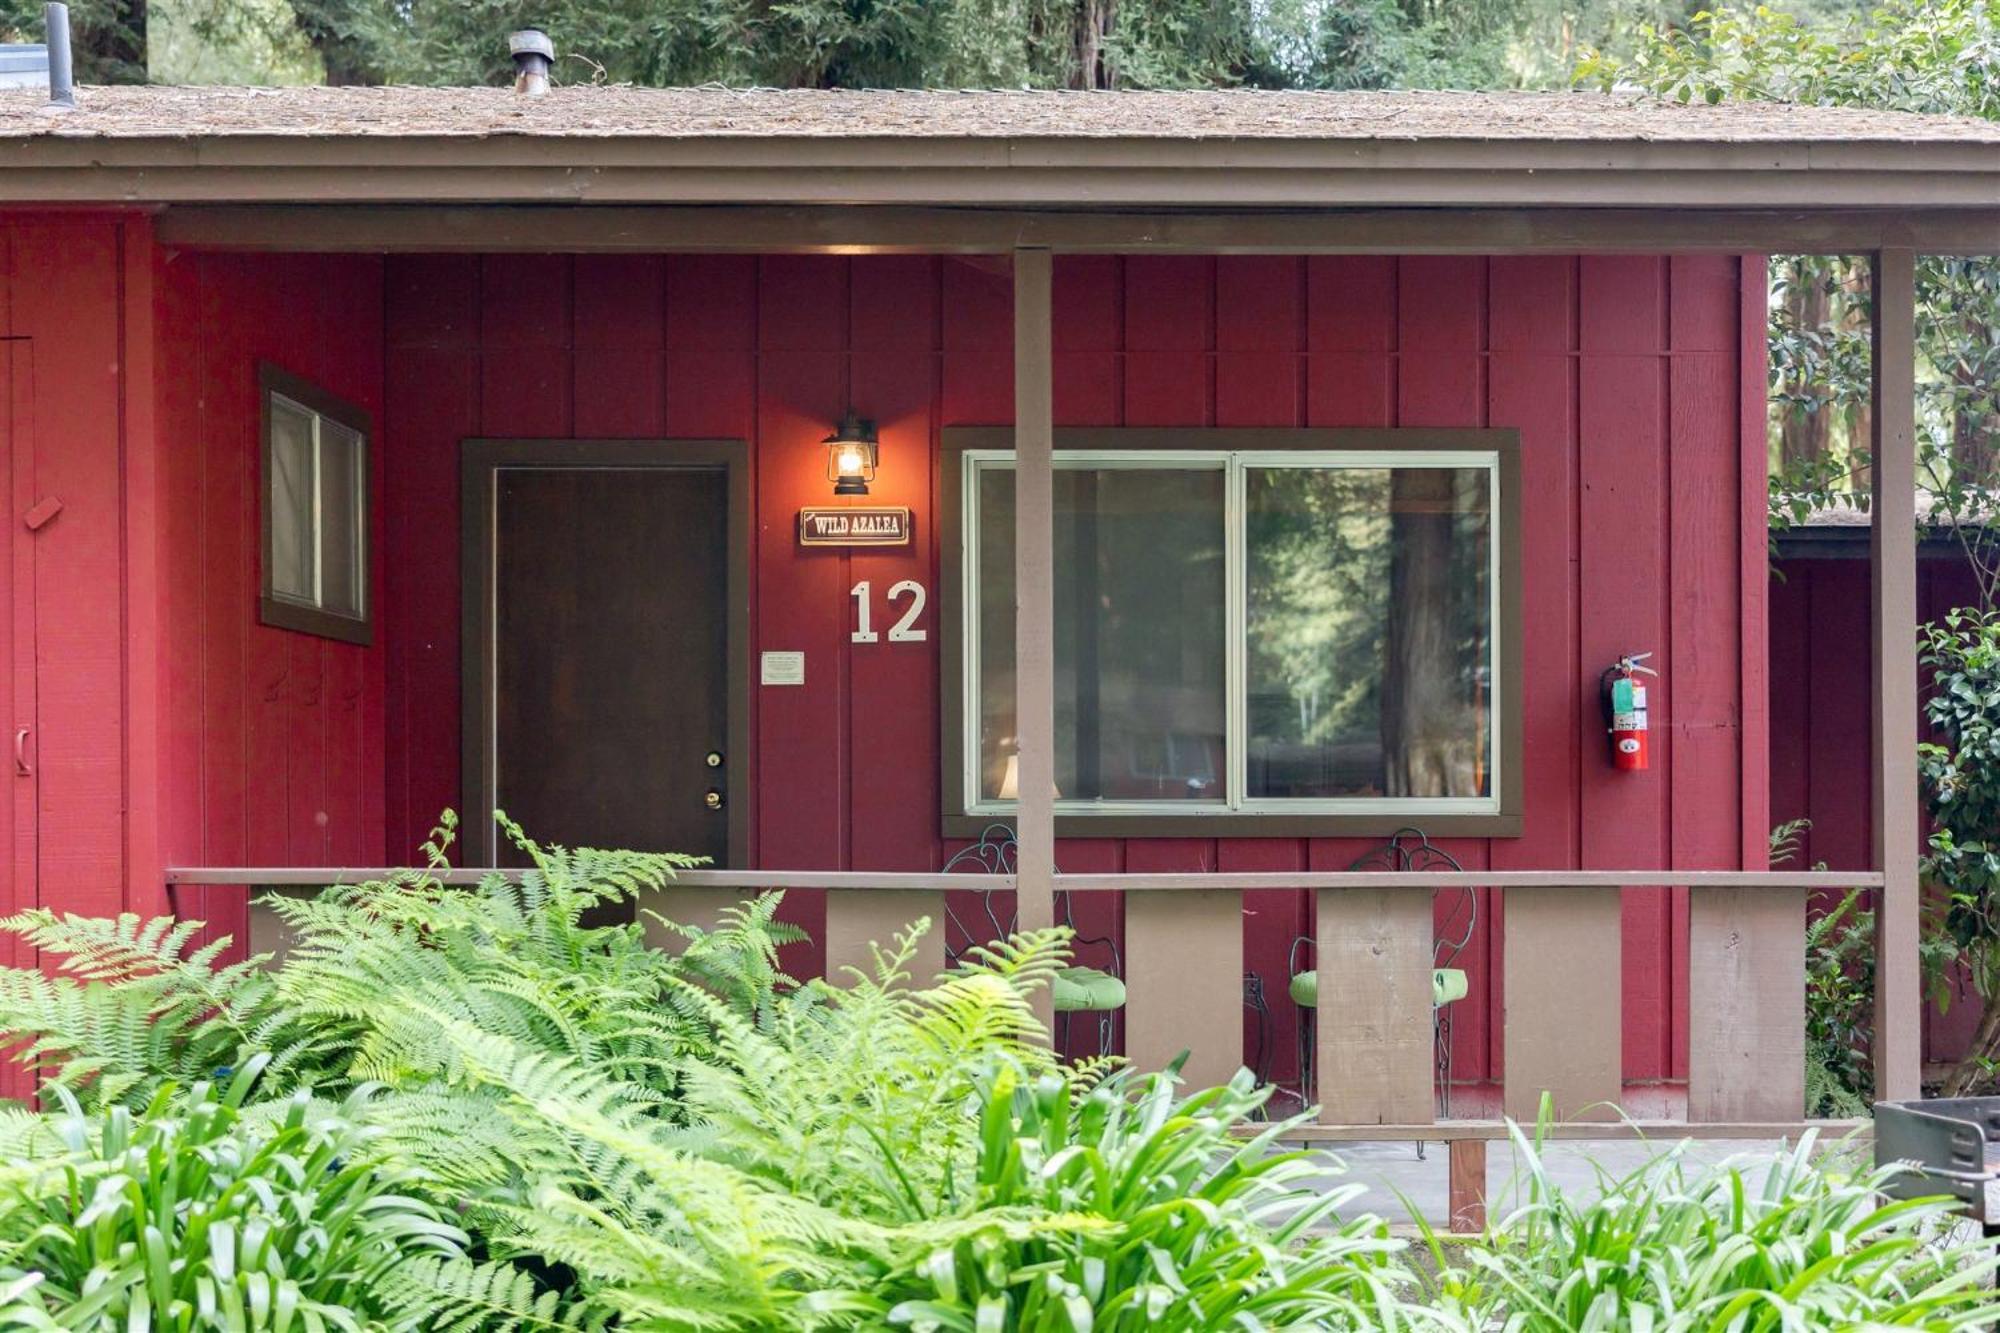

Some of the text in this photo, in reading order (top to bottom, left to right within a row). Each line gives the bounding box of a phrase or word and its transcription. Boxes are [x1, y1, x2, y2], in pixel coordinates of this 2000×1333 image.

[815, 516, 848, 534] WILD
[851, 516, 899, 533] AZALEA
[851, 580, 927, 643] 12
